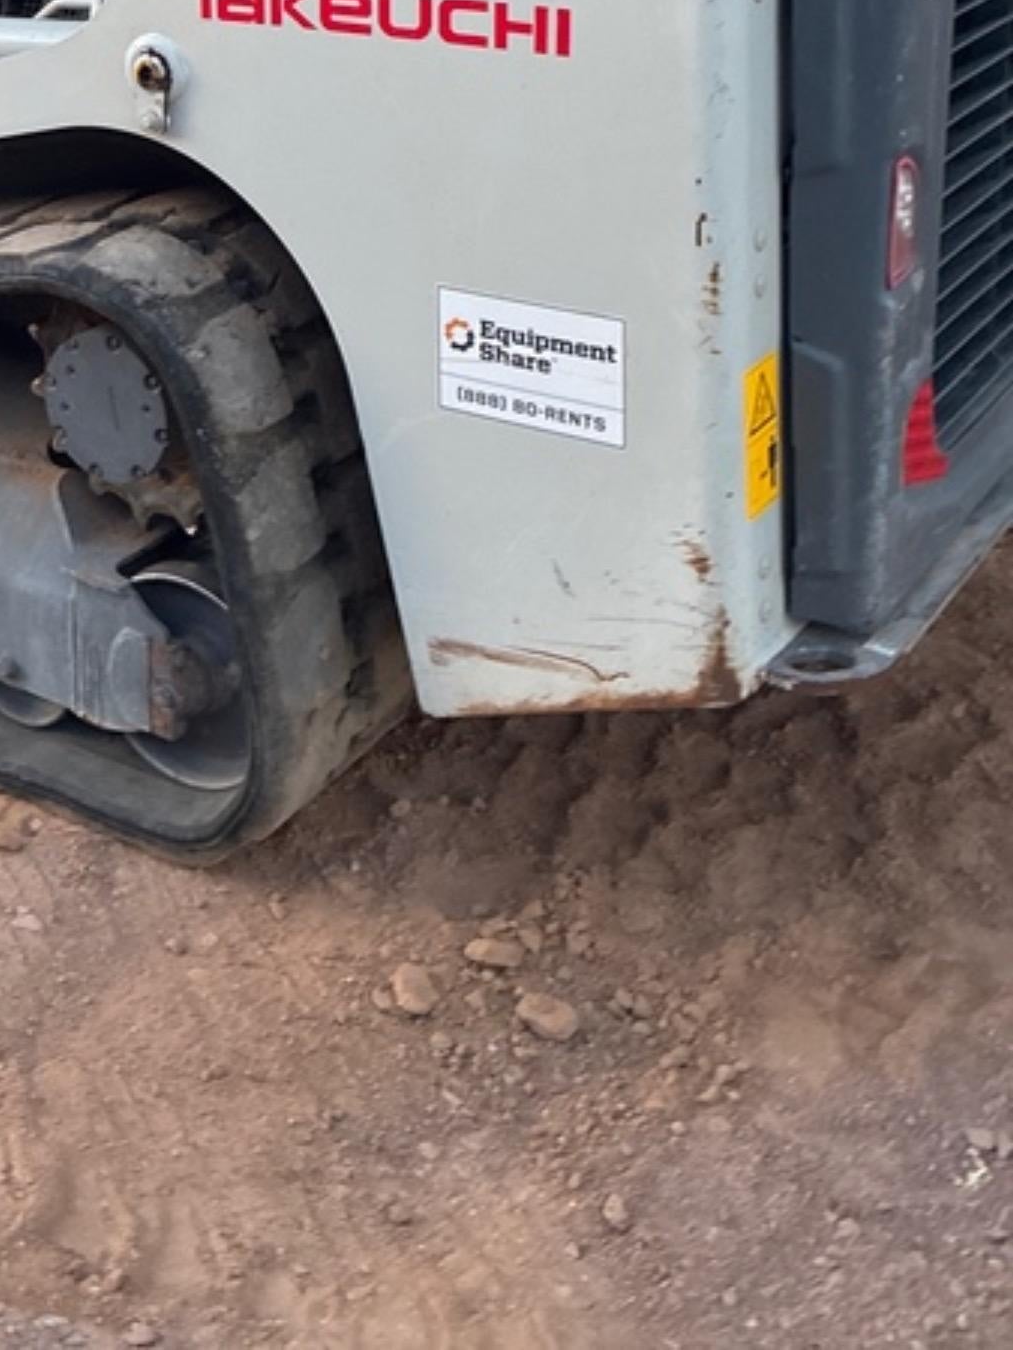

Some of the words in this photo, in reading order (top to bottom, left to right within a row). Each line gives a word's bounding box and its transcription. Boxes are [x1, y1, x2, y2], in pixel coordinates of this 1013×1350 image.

[479, 319, 617, 364] Equipment
[479, 342, 552, 374] Share
[457, 386, 507, 412] (888)
